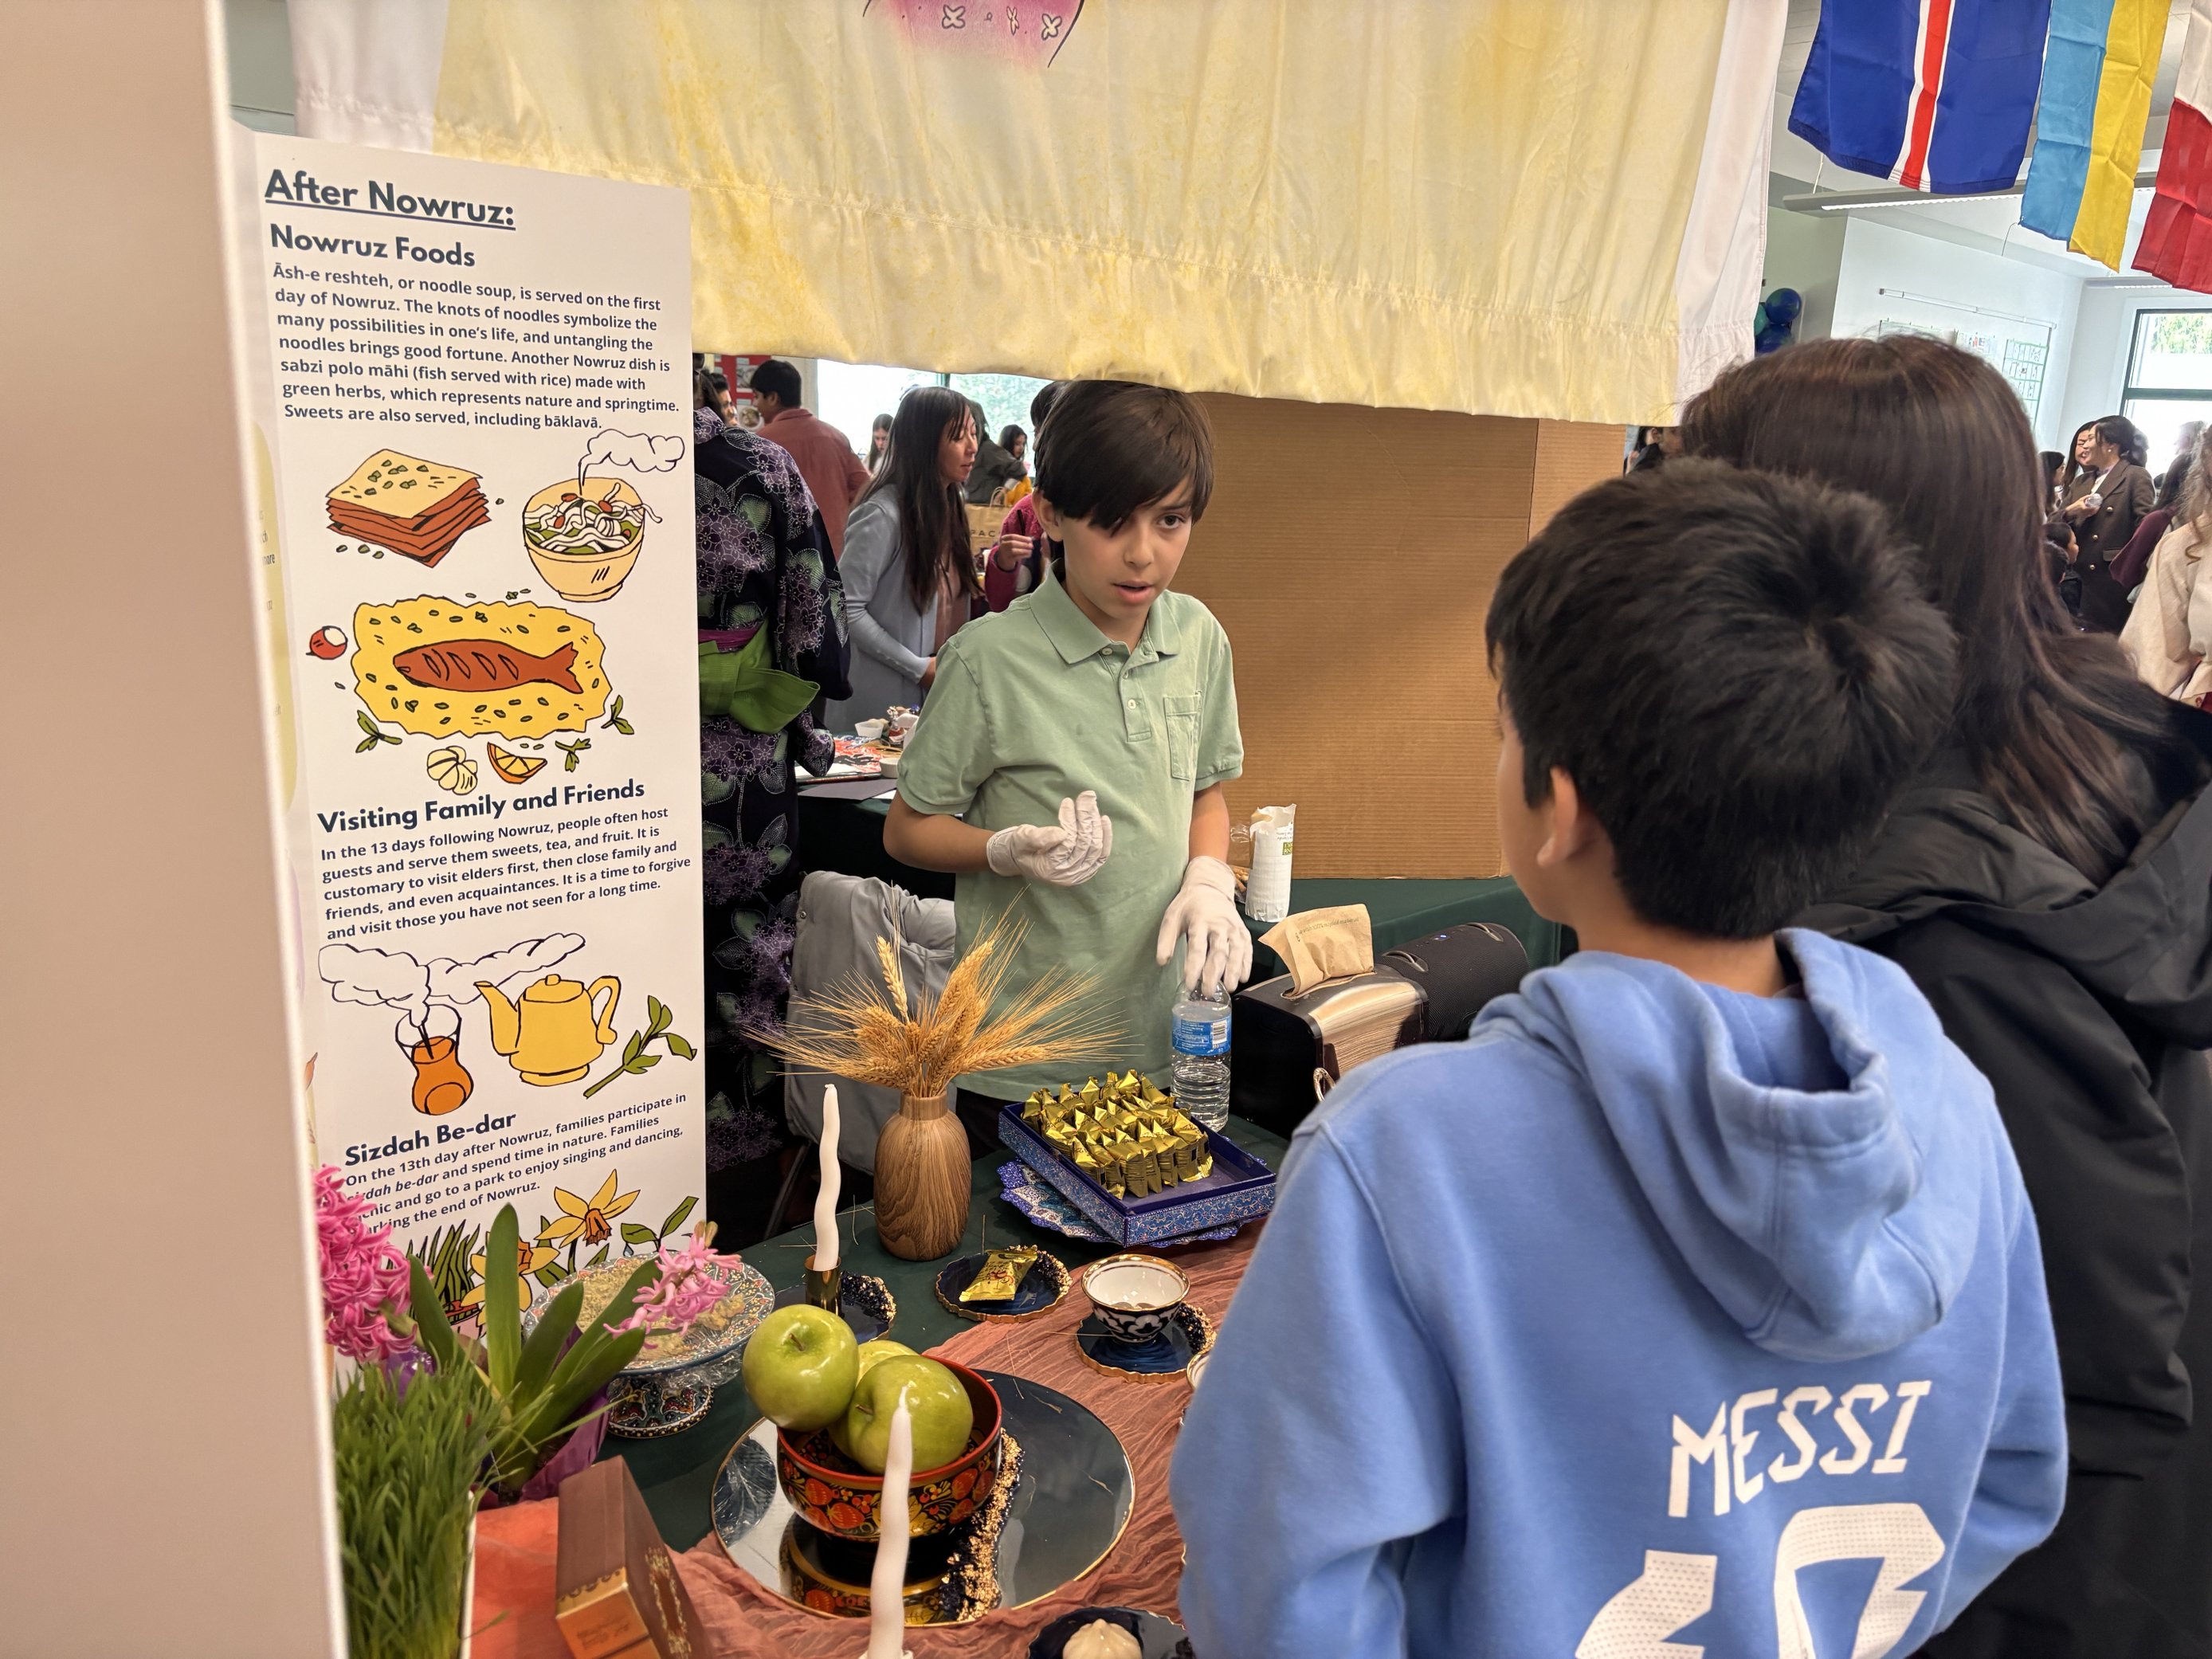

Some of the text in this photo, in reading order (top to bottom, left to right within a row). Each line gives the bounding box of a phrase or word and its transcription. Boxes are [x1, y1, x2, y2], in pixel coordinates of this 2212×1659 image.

[265, 169, 513, 226] After Nowruz:
[270, 223, 476, 267] Nowruz Foods
[273, 261, 661, 311] Āsh-e reshteh, or noodle soup, is served on the first
[275, 288, 657, 331] day of Nowruz. The knots of noodles symbolize the
[277, 314, 653, 352] many possibilities in one's life, and untangling the
[279, 336, 670, 372] noodles brings good fortune. Another Nowruz dish is
[280, 358, 645, 390] sabzi polo māhi (fish served with rice) made with
[282, 383, 680, 414] green herbs, which represents nature and springtime.
[284, 404, 602, 430] Sweets are also served, including bāklavā.
[316, 778, 645, 833] Visiting Family and Friends
[321, 807, 669, 861] In the 13 days following Nowruz, people often host
[322, 826, 660, 884] guests and serve them sweets, tea, and fruit. It is
[324, 840, 677, 900] customary to visit elders first, then close family and
[325, 857, 691, 920] friends, and even acquaintances. It is a time to forgive
[327, 880, 661, 940] and visit those you have not seen for a long time.
[344, 1113, 517, 1167] Sizdah Be-dar
[345, 1093, 686, 1186] On the 13th day after Nowruz, families participate in
[394, 1173, 440, 1193] be-dar
[441, 1163, 468, 1180] and
[471, 1152, 511, 1174] spend
[514, 1147, 544, 1161] time
[547, 1142, 559, 1153] in
[563, 1131, 607, 1149] nature.
[610, 1116, 660, 1137] Families
[394, 1193, 422, 1210] and
[425, 1190, 441, 1205] go
[445, 1186, 460, 1197] to
[463, 1182, 471, 1192] a
[475, 1172, 505, 1192] park
[508, 1169, 522, 1180] to
[524, 1159, 560, 1175] enjoy
[563, 1147, 606, 1166] singing
[609, 1137, 631, 1153] and
[413, 1209, 437, 1222] the
[441, 1198, 466, 1215] end
[469, 1194, 484, 1207] of
[486, 1182, 540, 1202] Nowruz.
[1668, 1380, 1933, 1517] MESSI
